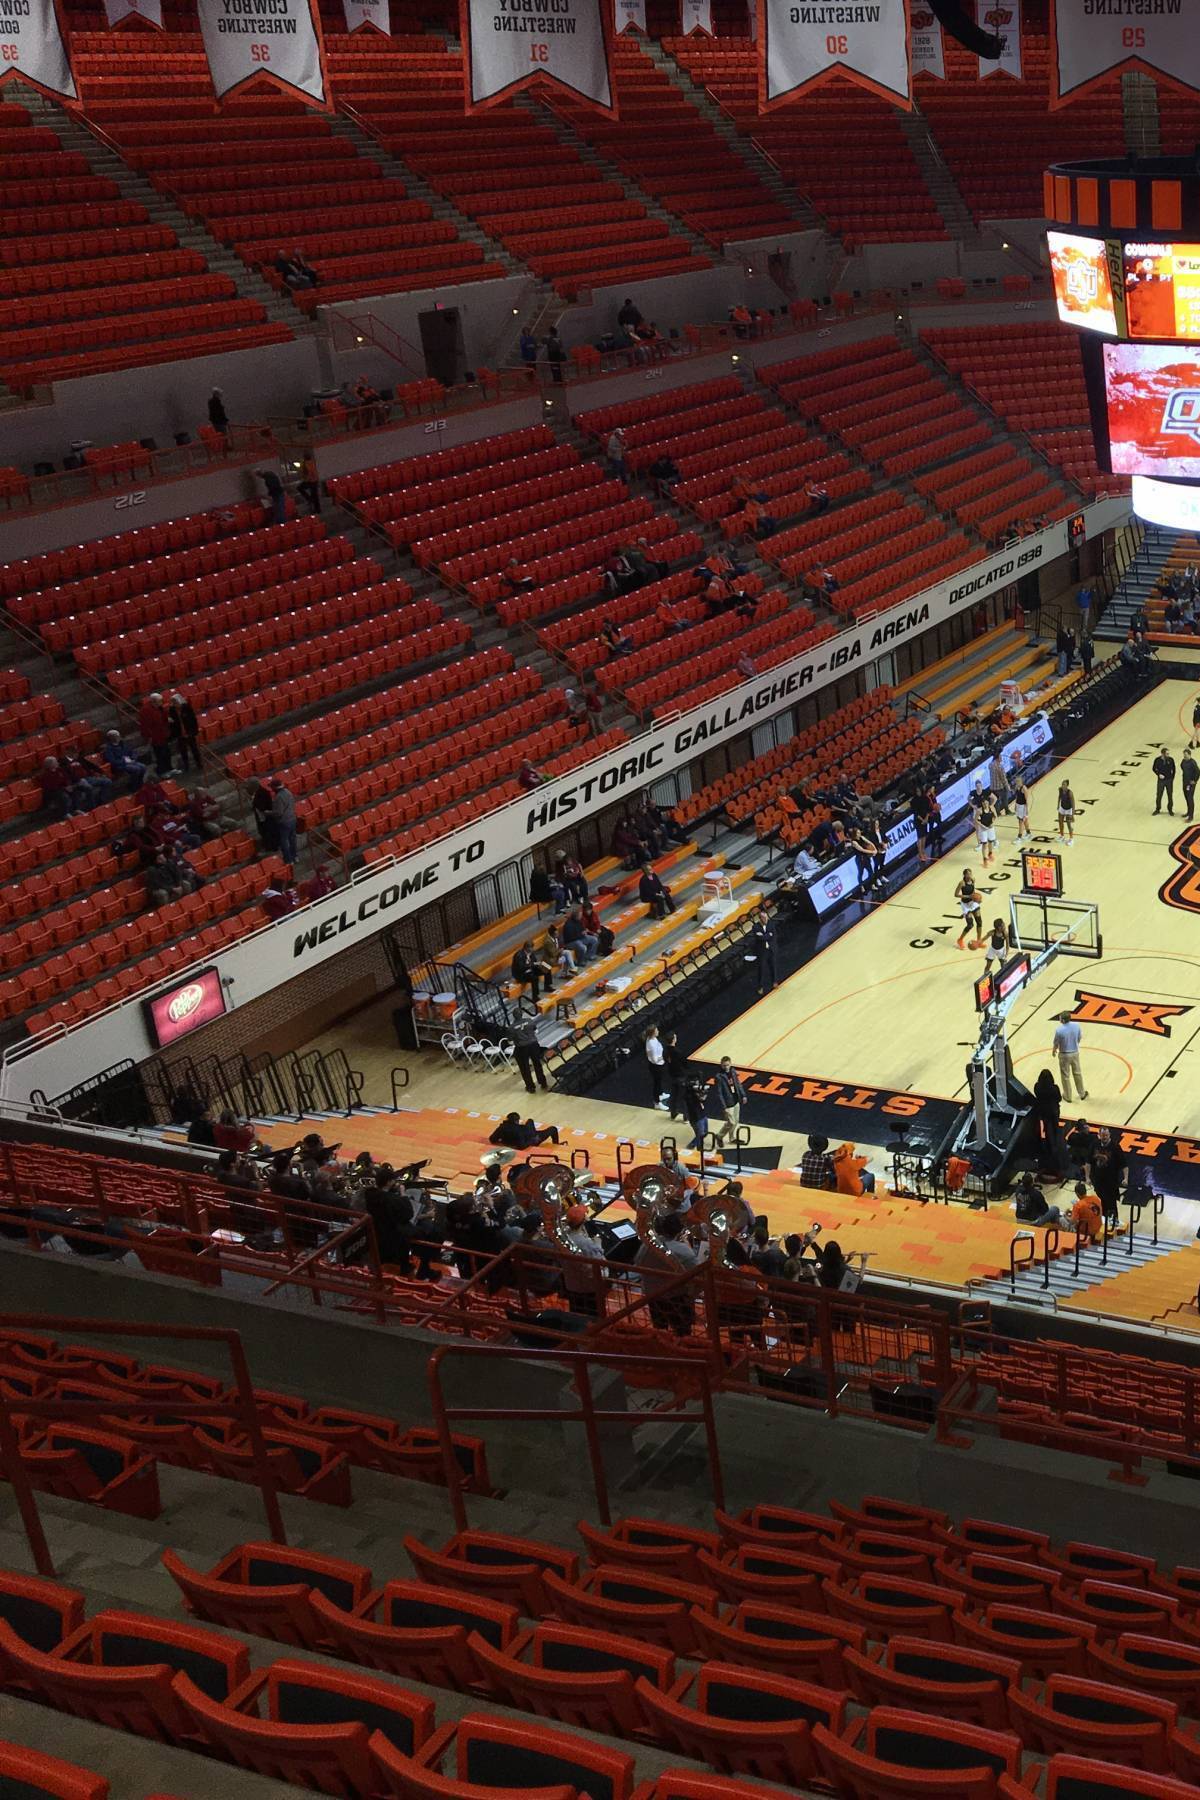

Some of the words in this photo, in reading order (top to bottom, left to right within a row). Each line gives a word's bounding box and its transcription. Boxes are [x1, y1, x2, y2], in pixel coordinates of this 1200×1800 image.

[1108, 243, 1123, 302] Hertz
[424, 420, 447, 434] 213
[114, 491, 146, 509] 212
[293, 861, 440, 958] WELCOME
[448, 839, 486, 872] TO
[526, 743, 664, 834] HISTORIC
[674, 639, 862, 754] GALLAGHER-IBA
[869, 603, 930, 650] ARENA
[949, 563, 1015, 605] DEDICATED
[1016, 545, 1043, 568] 1938
[1101, 743, 1164, 787] ARENA
